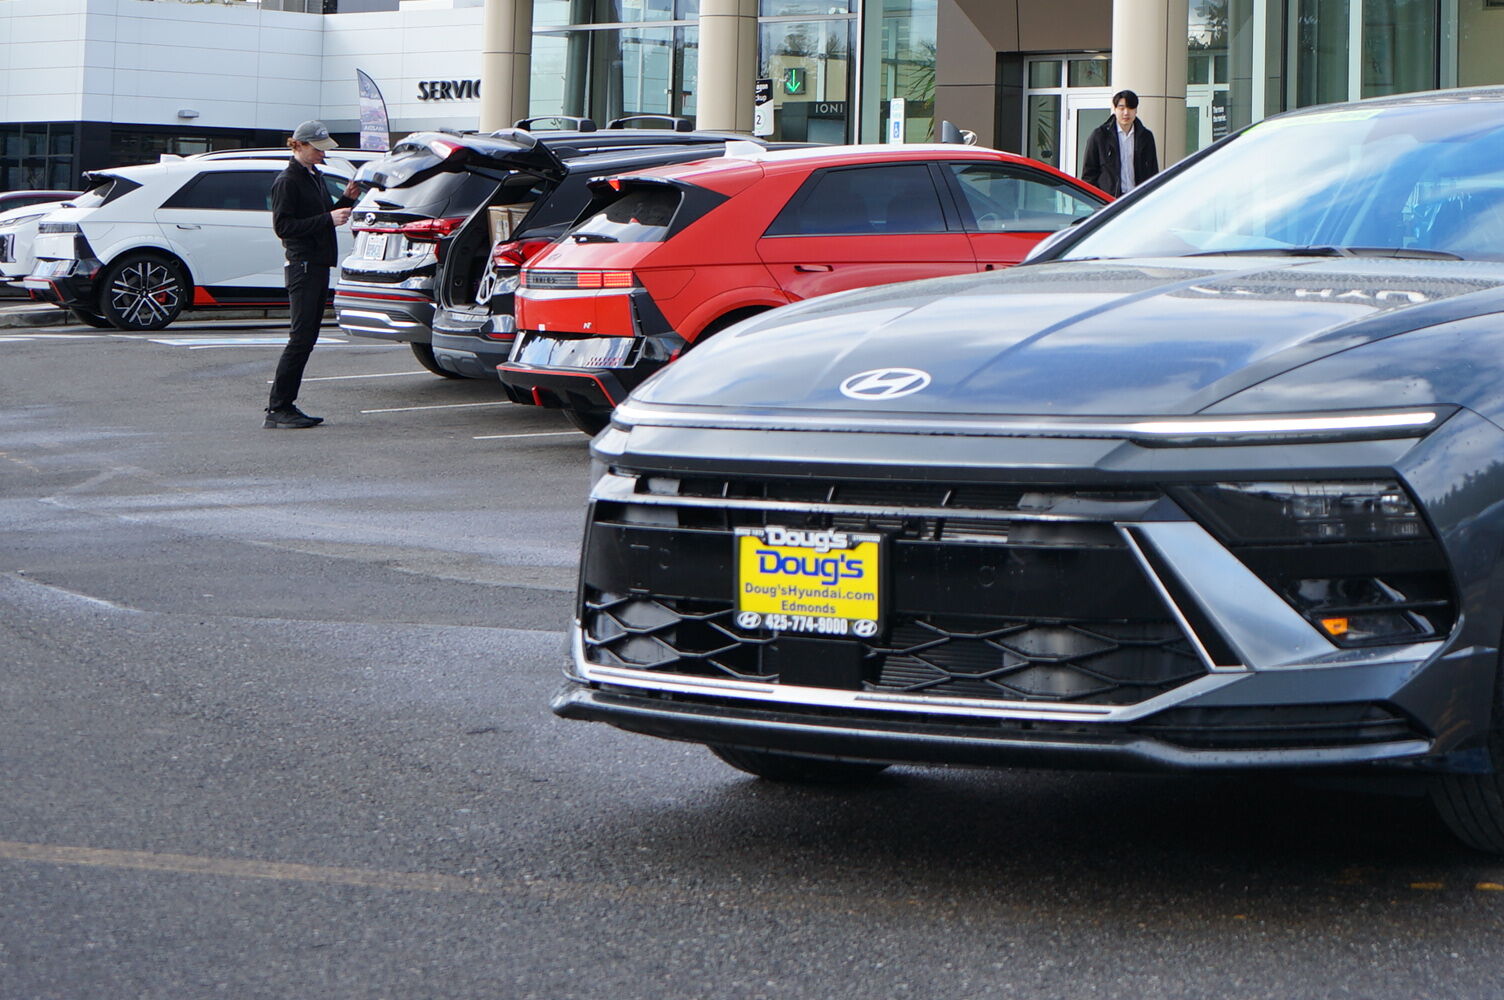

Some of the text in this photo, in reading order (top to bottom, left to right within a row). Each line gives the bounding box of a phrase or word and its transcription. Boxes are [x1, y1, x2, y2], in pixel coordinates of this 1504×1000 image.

[765, 525, 848, 553] Doug's
[755, 550, 864, 586] Doug's
[744, 582, 875, 601] Doug'sHyundai.com
[781, 600, 836, 614] Edmonds
[765, 613, 848, 635] 425-774-9000
